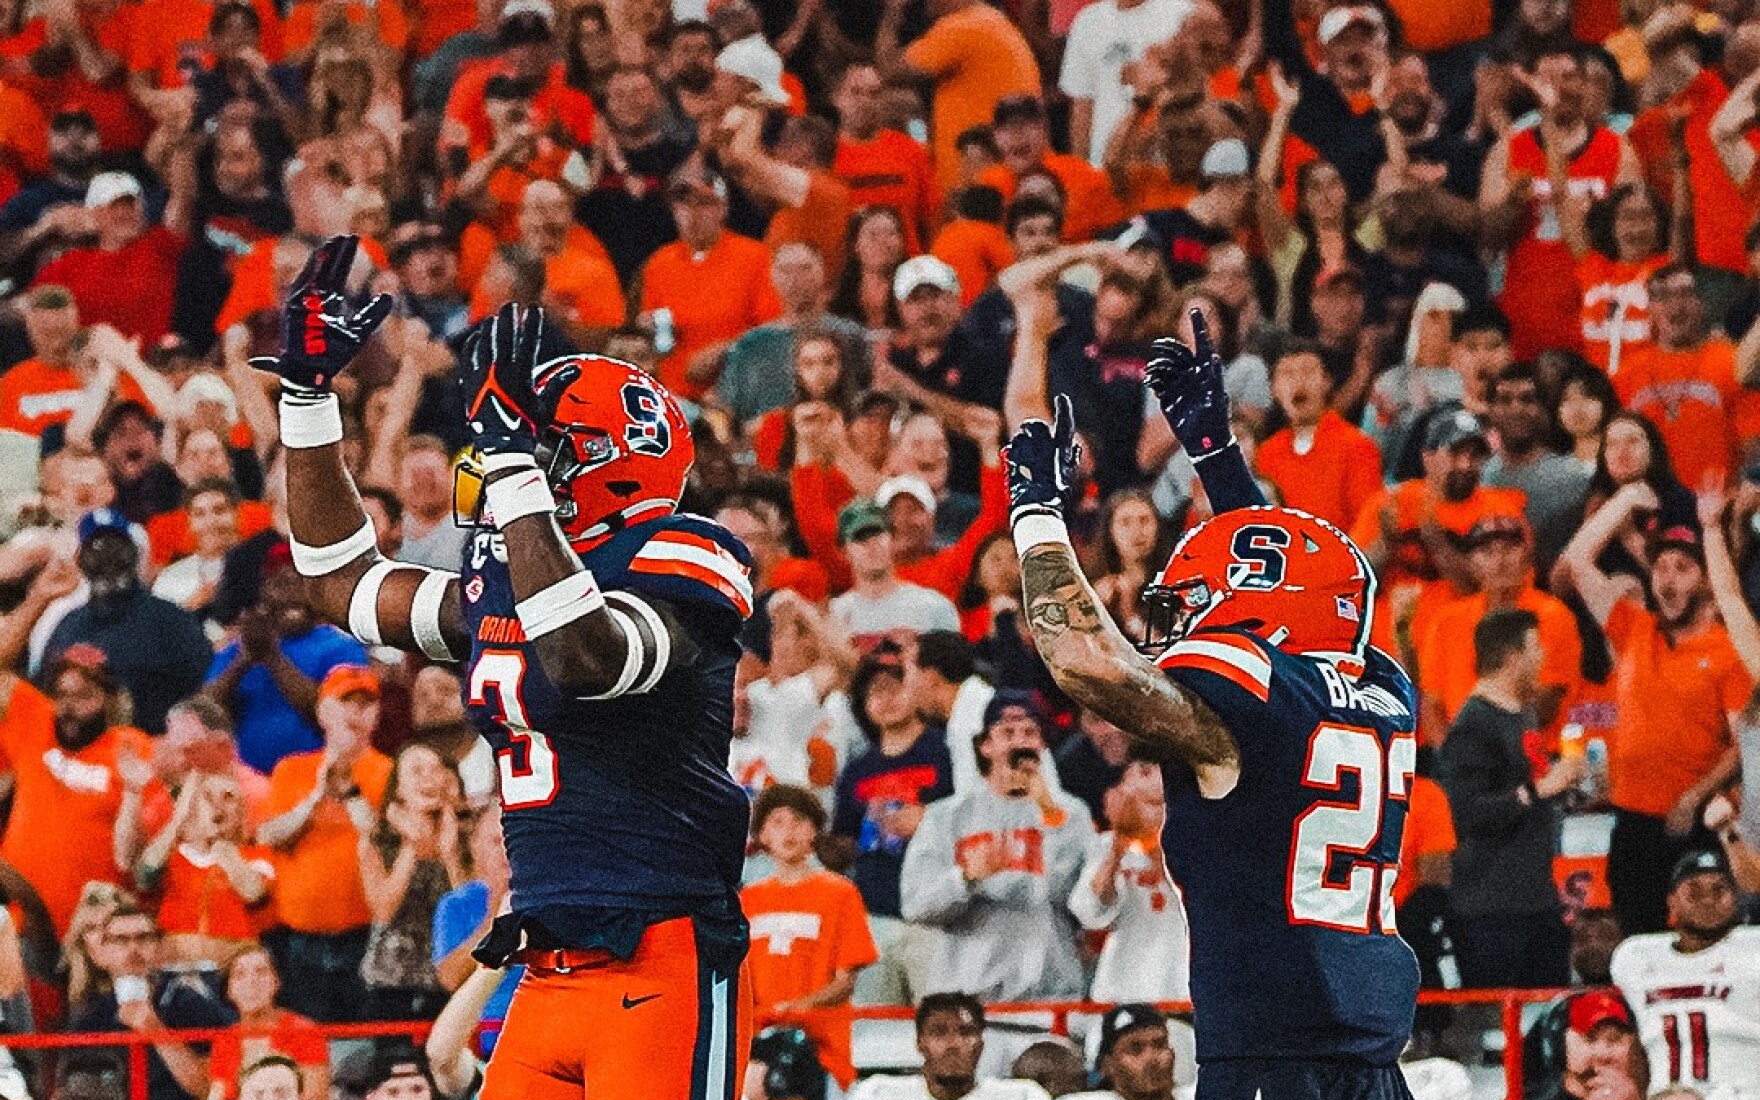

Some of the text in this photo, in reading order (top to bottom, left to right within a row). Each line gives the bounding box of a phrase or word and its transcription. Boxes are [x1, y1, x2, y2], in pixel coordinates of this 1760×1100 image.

[619, 383, 672, 458] S
[1227, 524, 1291, 592] S
[468, 648, 562, 812] 3
[1662, 1012, 1709, 1082] 11
